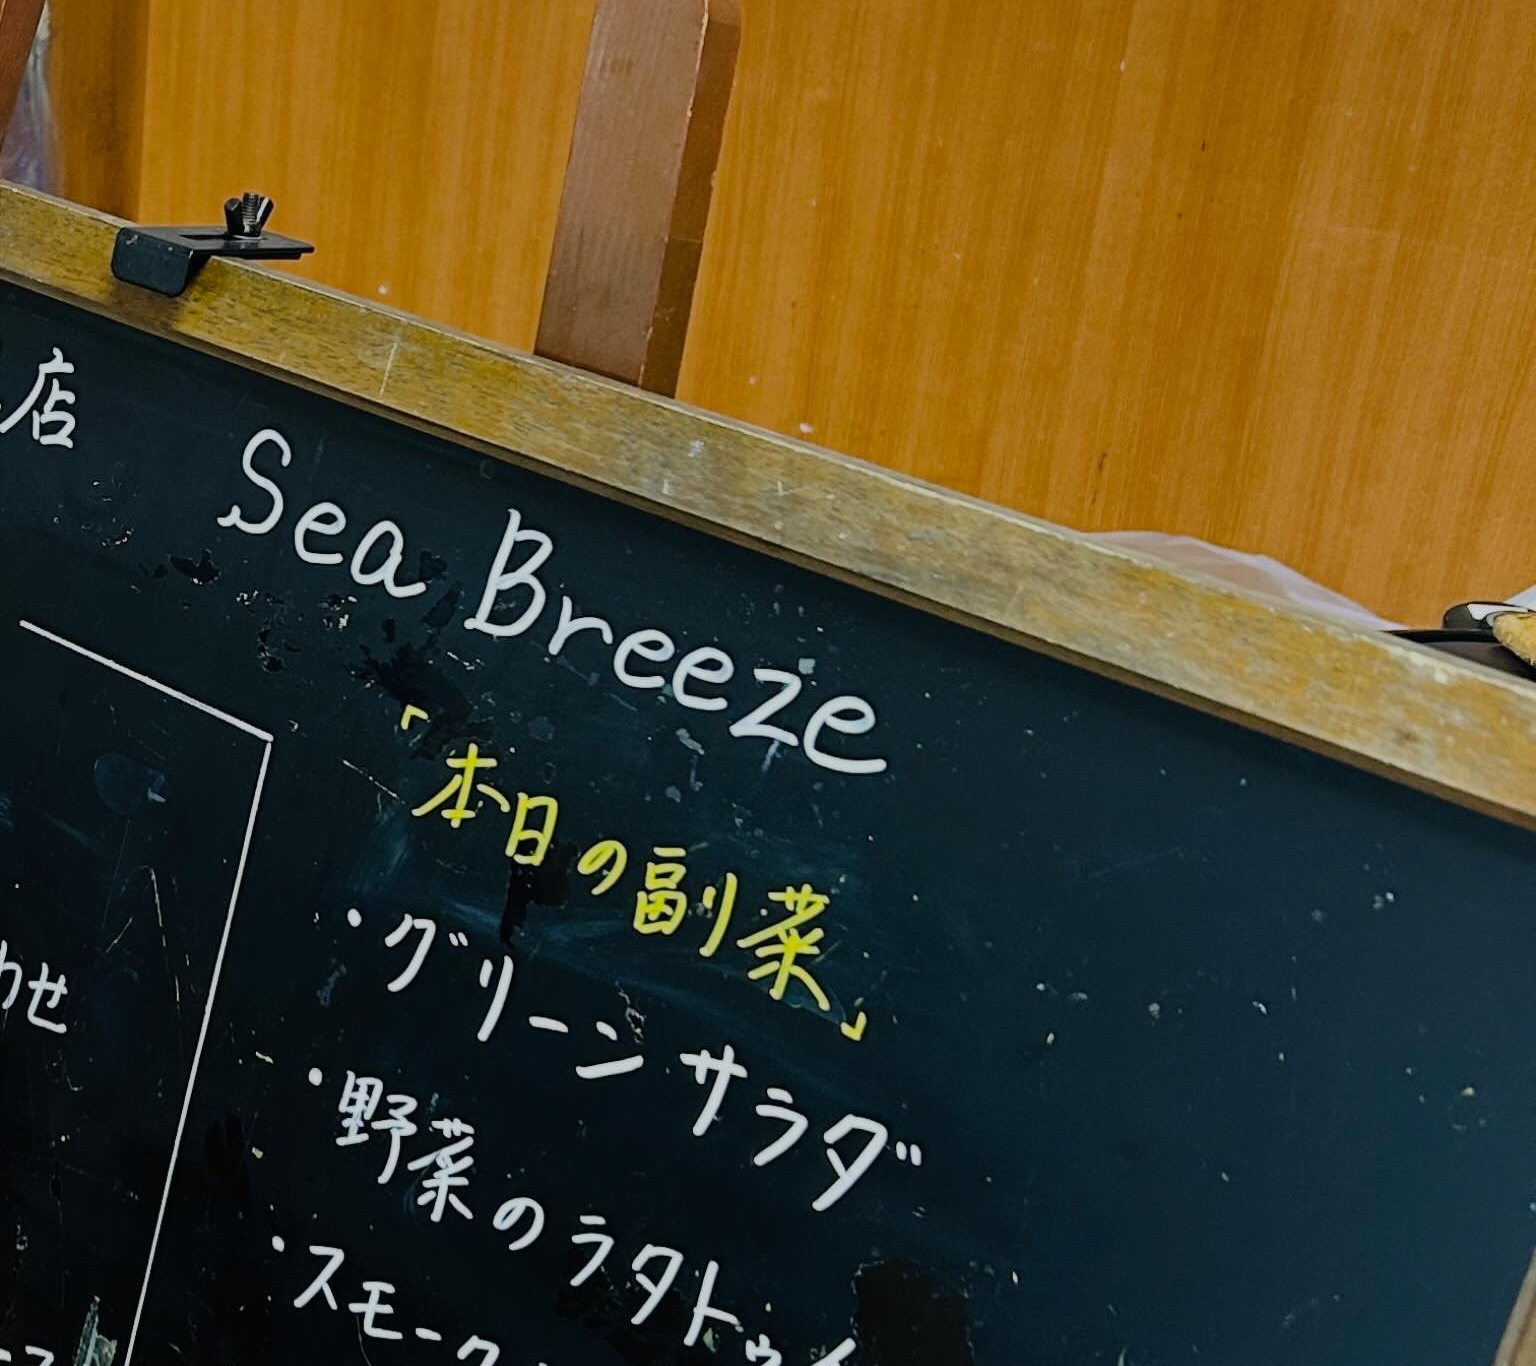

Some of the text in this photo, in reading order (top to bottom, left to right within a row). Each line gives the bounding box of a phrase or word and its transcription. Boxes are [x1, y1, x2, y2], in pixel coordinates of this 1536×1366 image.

[217, 428, 888, 775] Sea Breeze
[401, 704, 867, 1041] 「本日の副菜」
